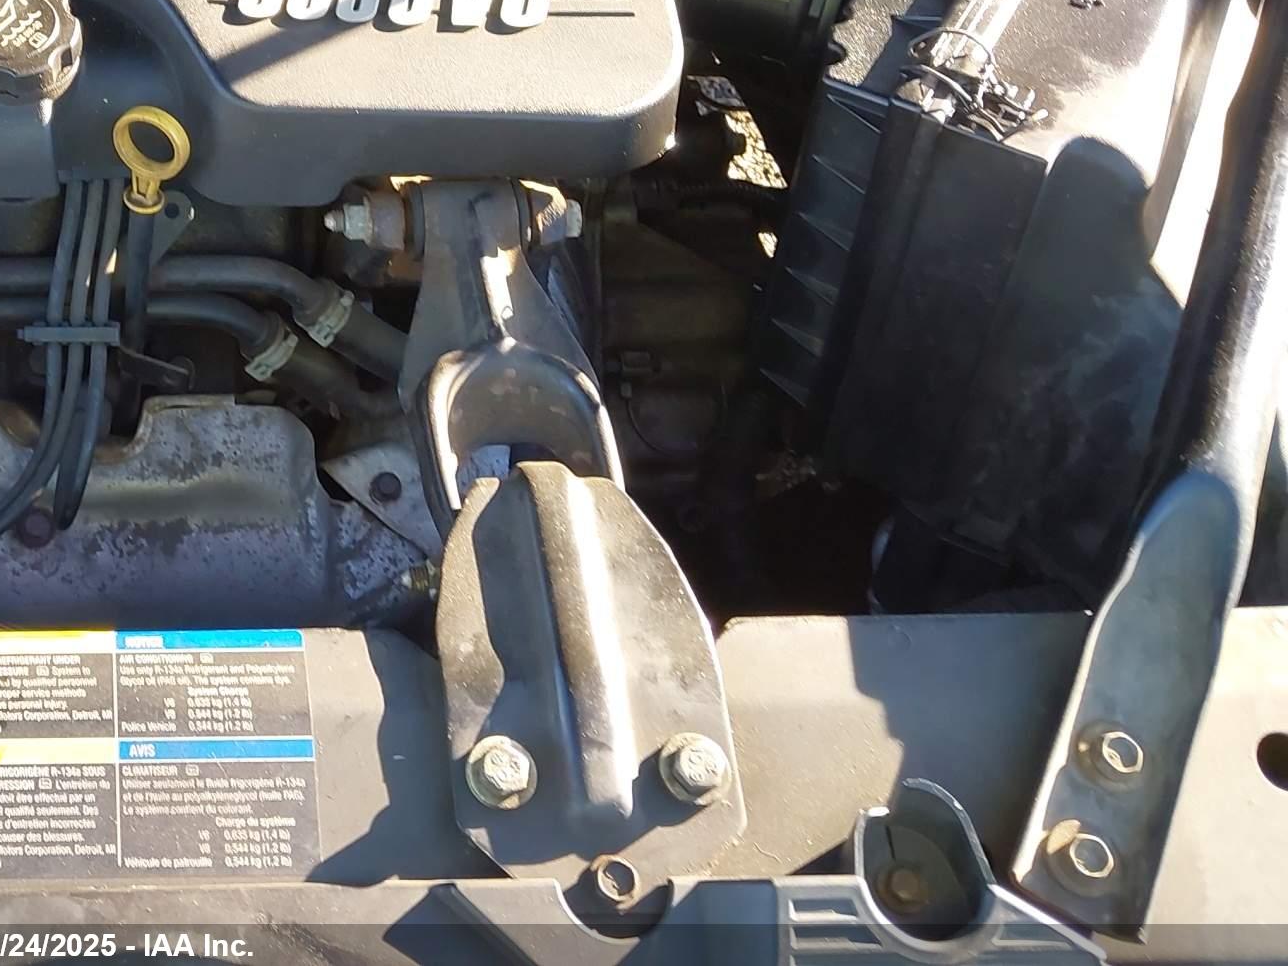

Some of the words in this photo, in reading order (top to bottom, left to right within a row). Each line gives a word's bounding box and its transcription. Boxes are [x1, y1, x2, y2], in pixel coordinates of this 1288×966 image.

[129, 744, 156, 757] AVIS
[82, 766, 106, 777] SOUS
[83, 805, 99, 815] Des
